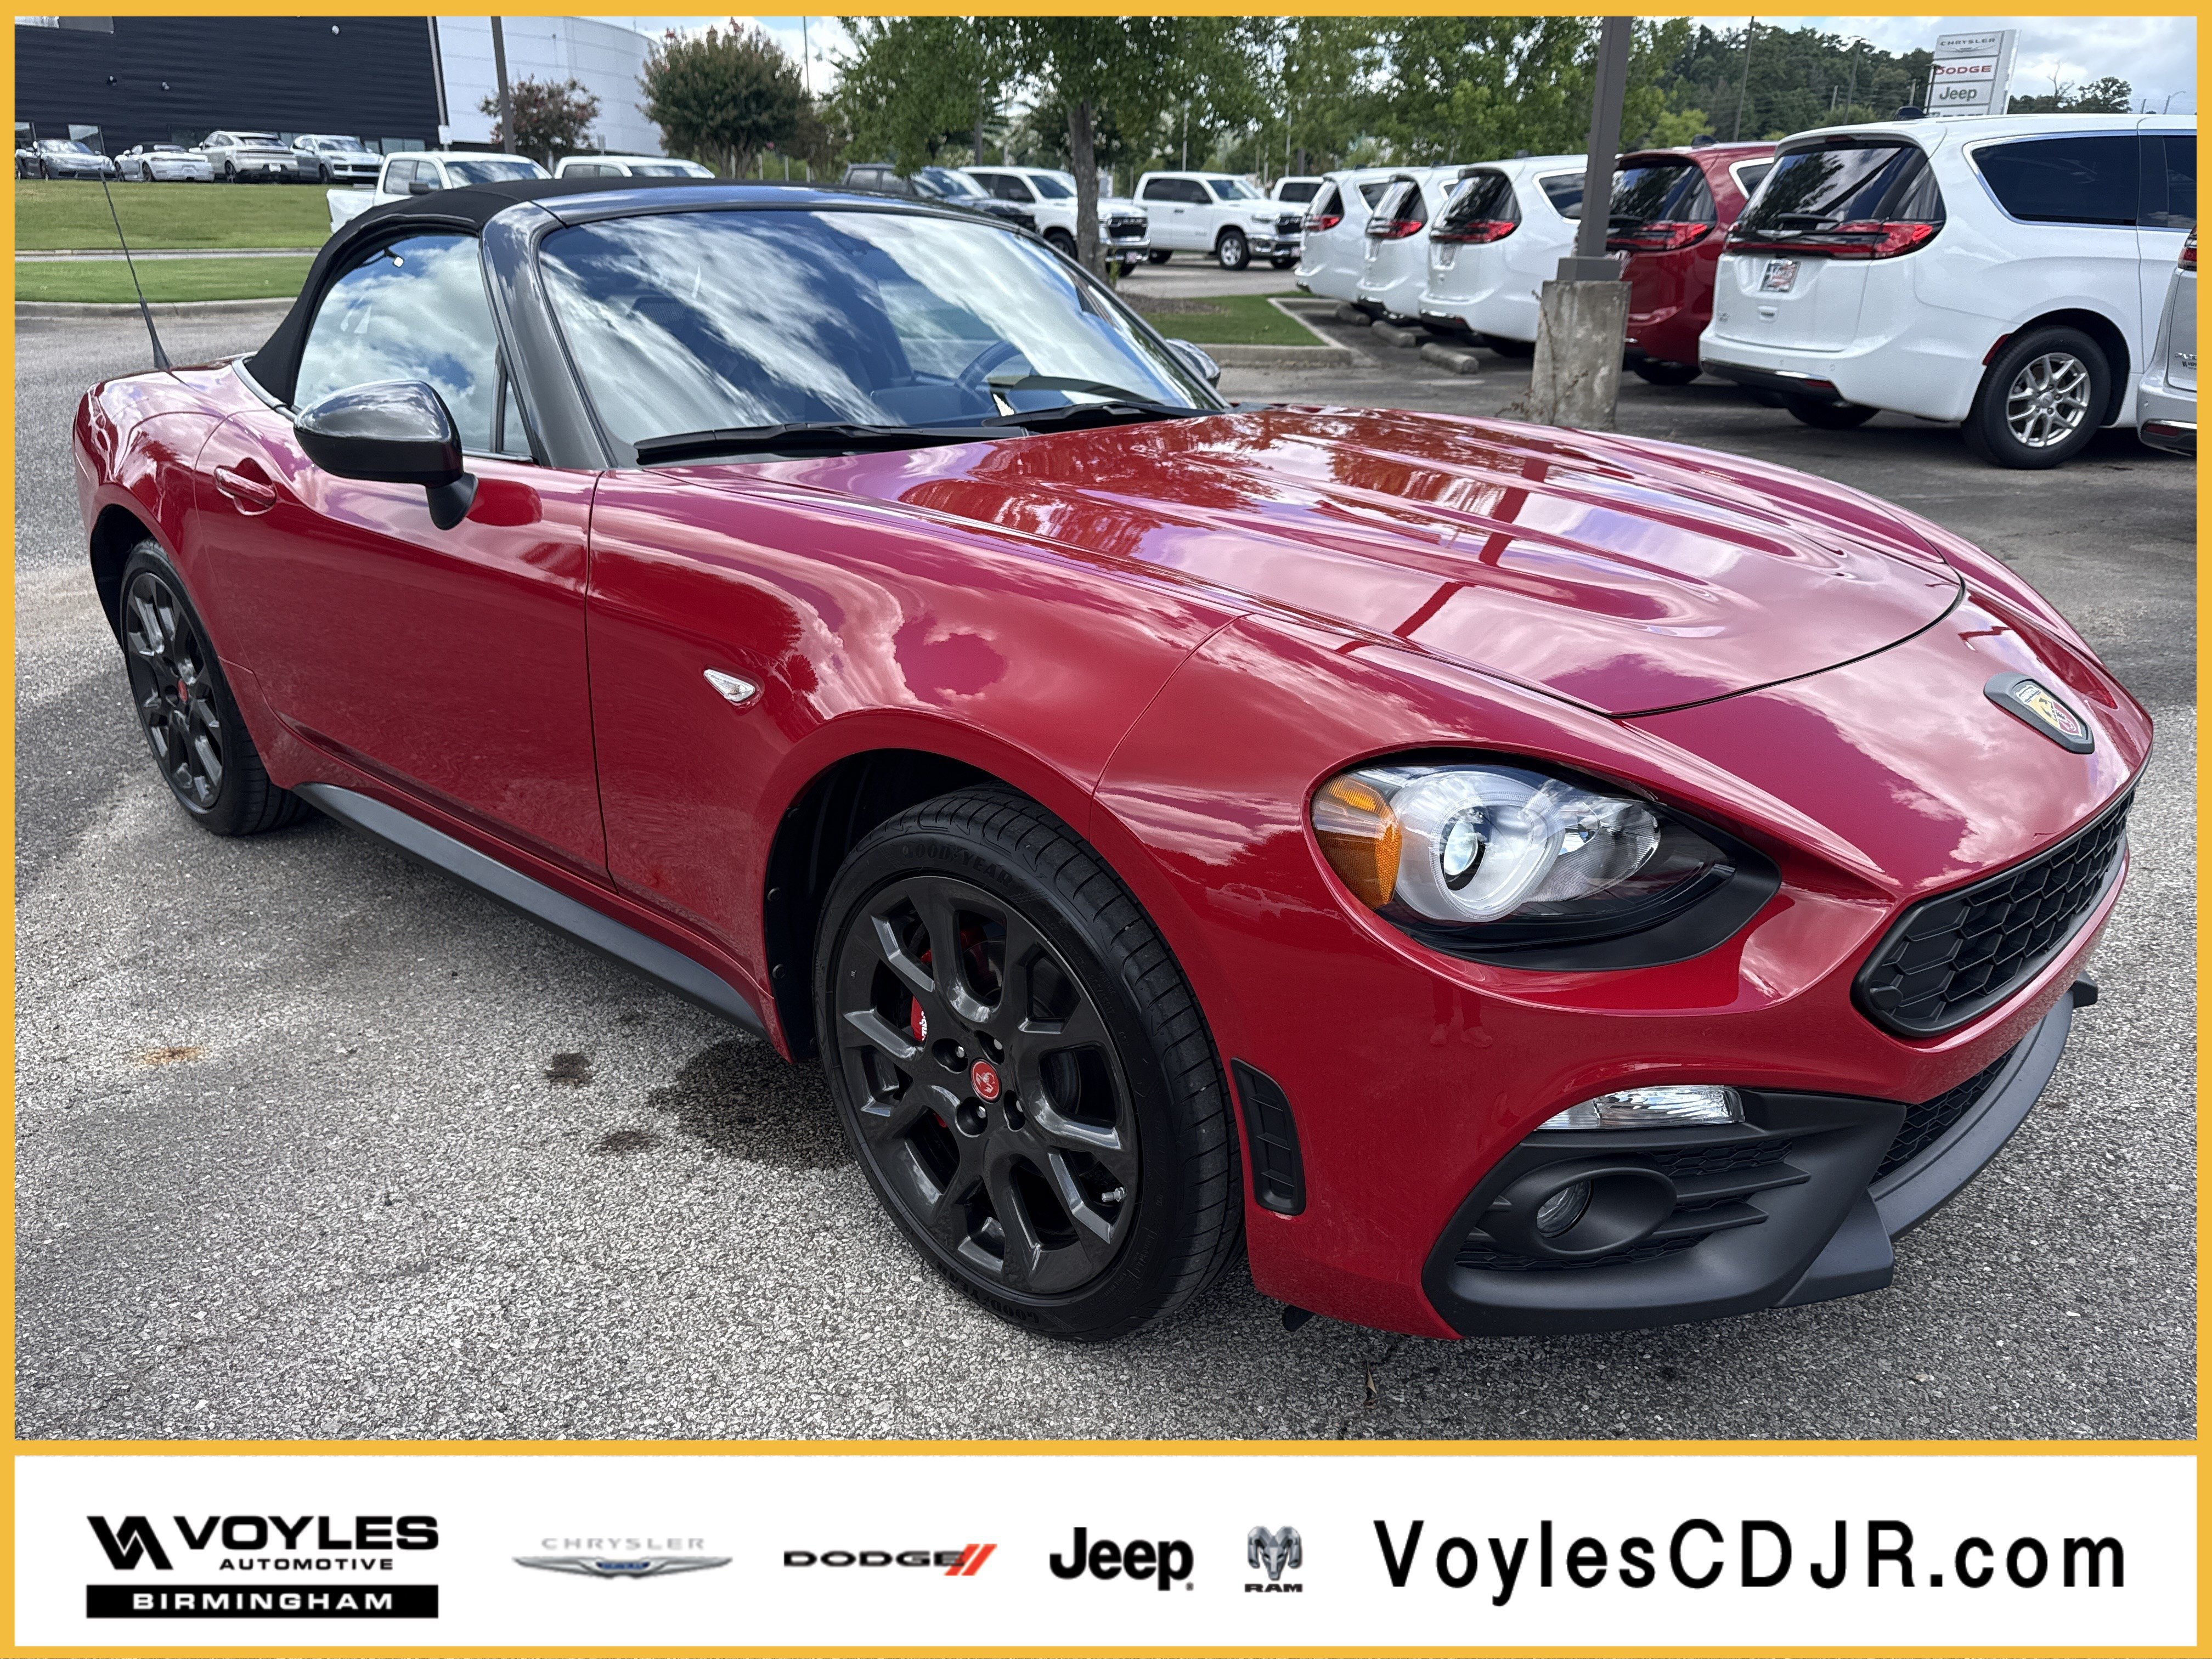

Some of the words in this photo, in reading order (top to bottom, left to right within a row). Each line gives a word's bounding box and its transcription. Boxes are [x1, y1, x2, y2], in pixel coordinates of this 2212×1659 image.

[1940, 38, 1995, 46] CHRYSLER
[1936, 65, 1992, 75] DODGE
[1939, 87, 1978, 101] Jeep
